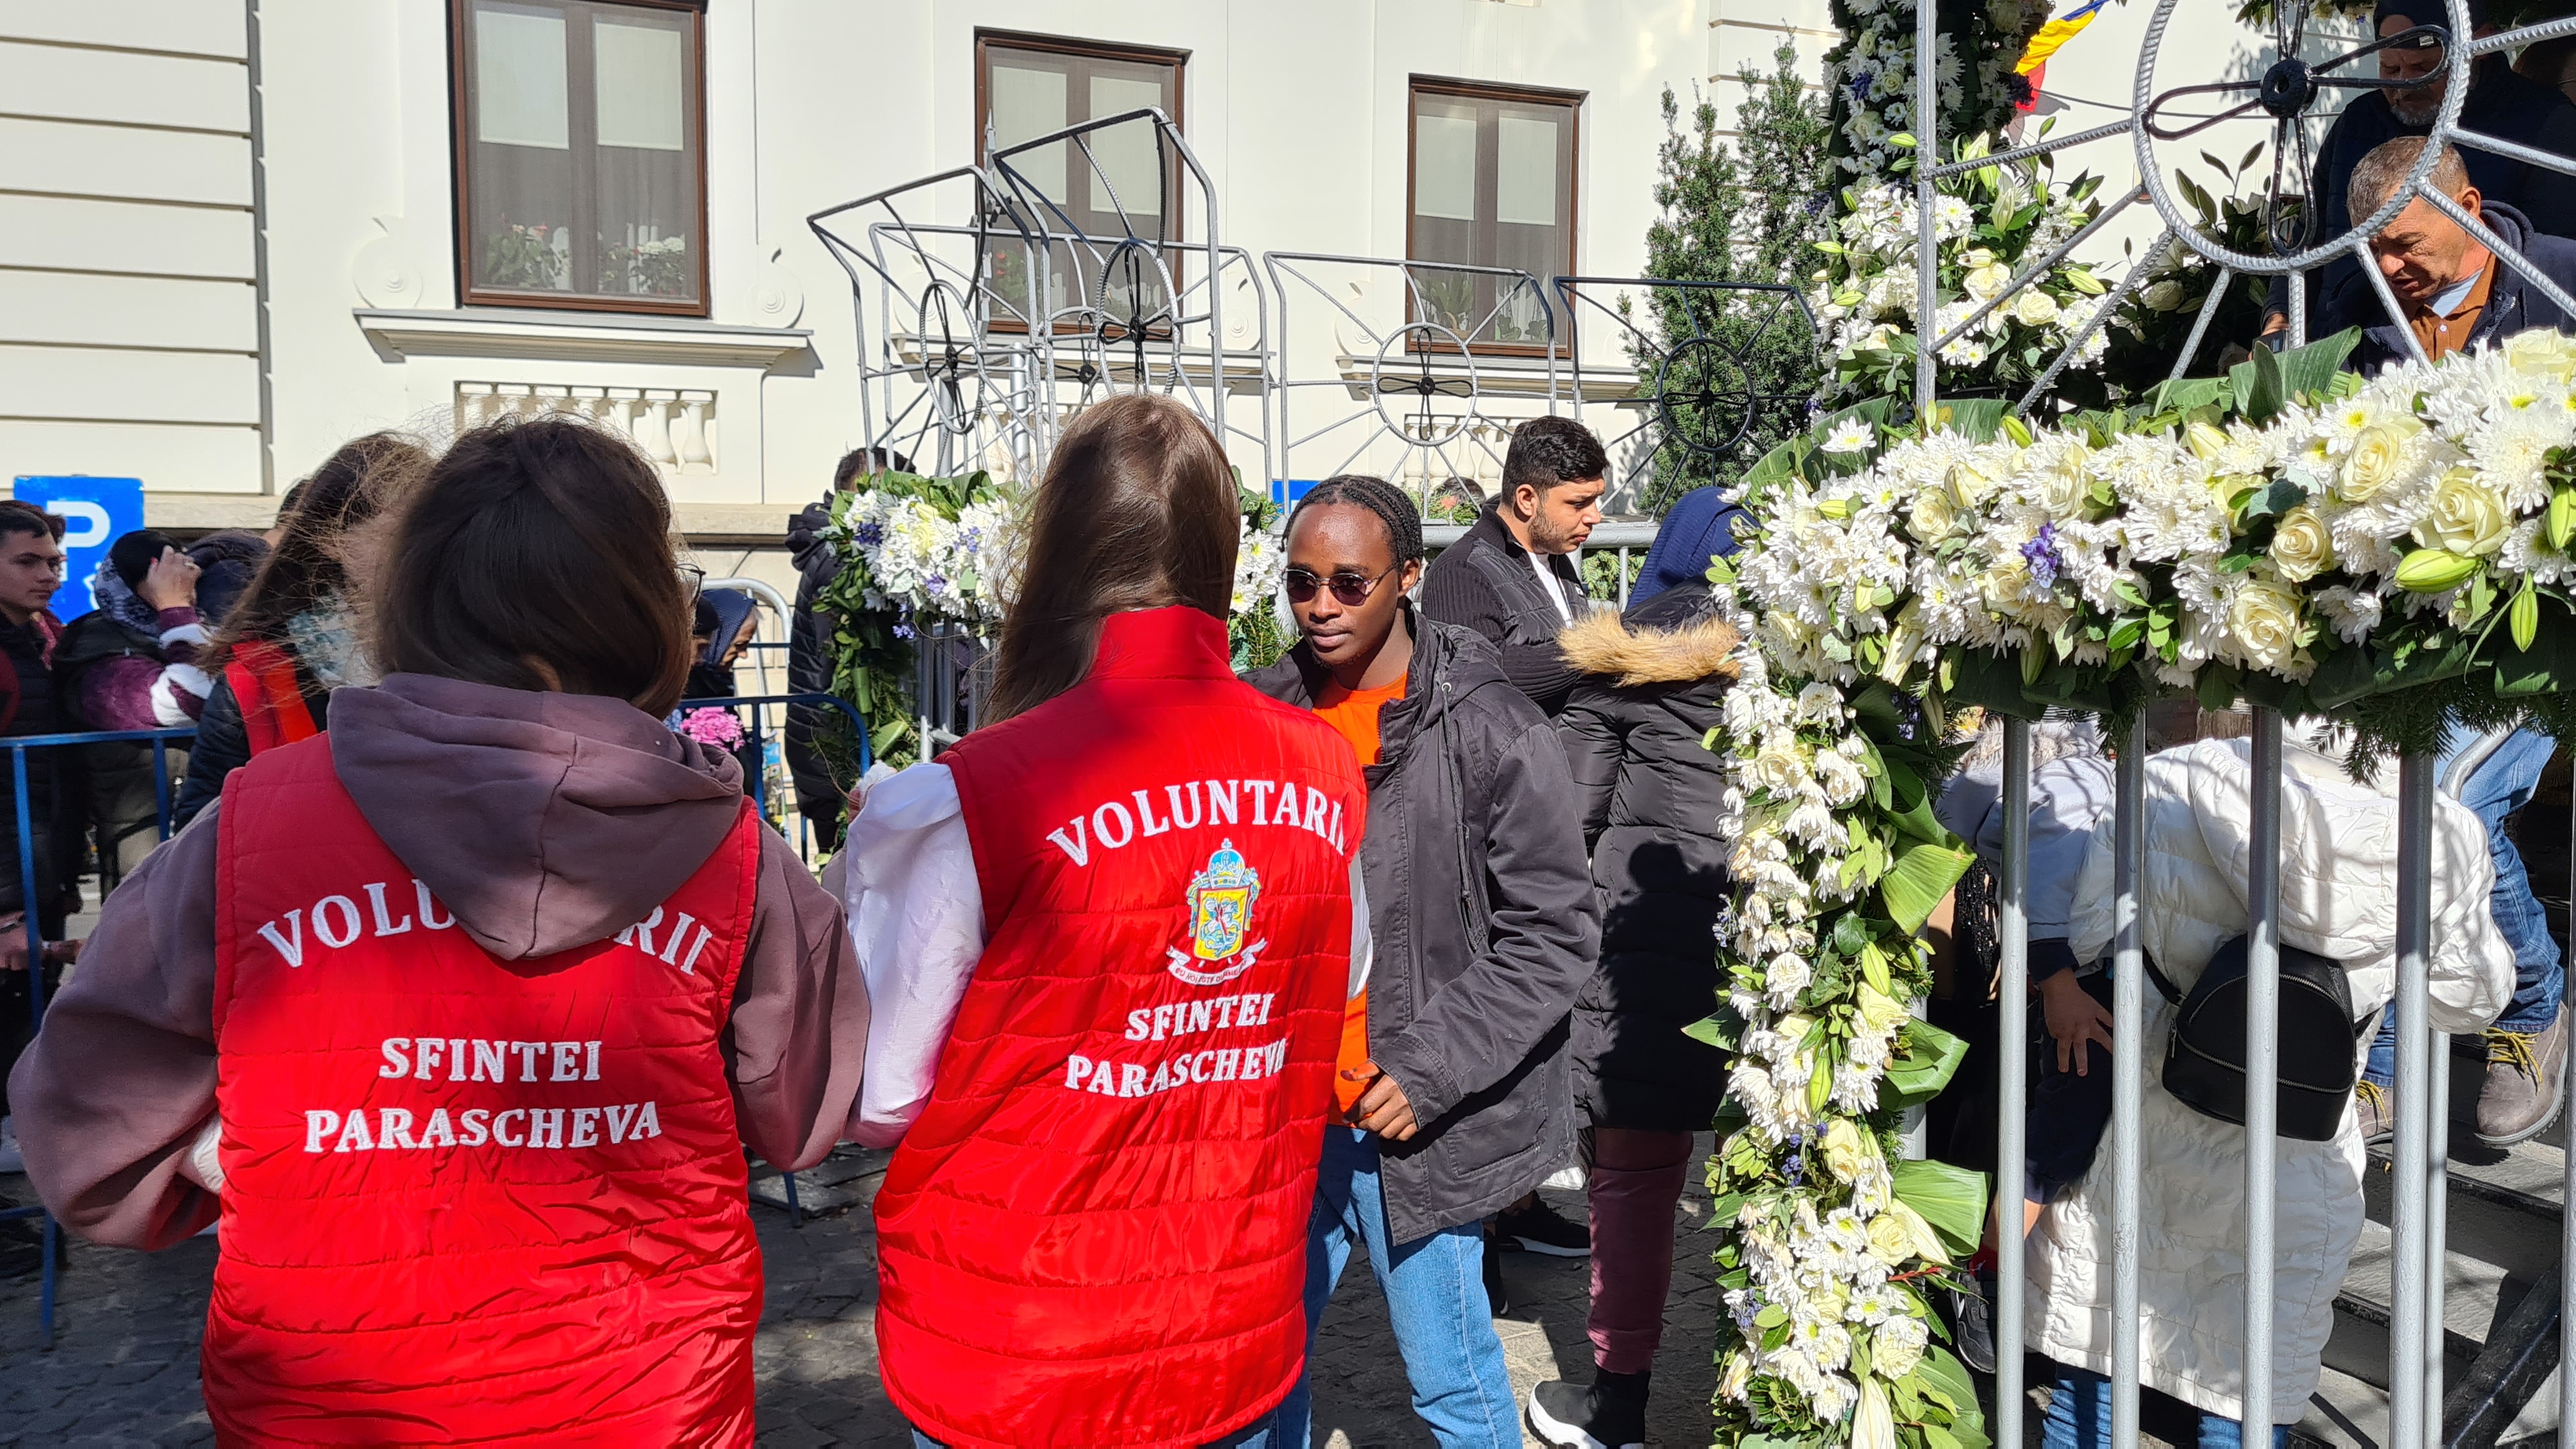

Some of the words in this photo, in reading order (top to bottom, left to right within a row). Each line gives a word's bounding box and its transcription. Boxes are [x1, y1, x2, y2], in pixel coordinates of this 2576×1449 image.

[47, 501, 111, 581] P
[257, 878, 713, 975] VOLURII
[1124, 993, 1275, 1041] SFINTEI
[379, 1038, 602, 1083] SFINTEI
[304, 1101, 662, 1153] PARASCHEVA
